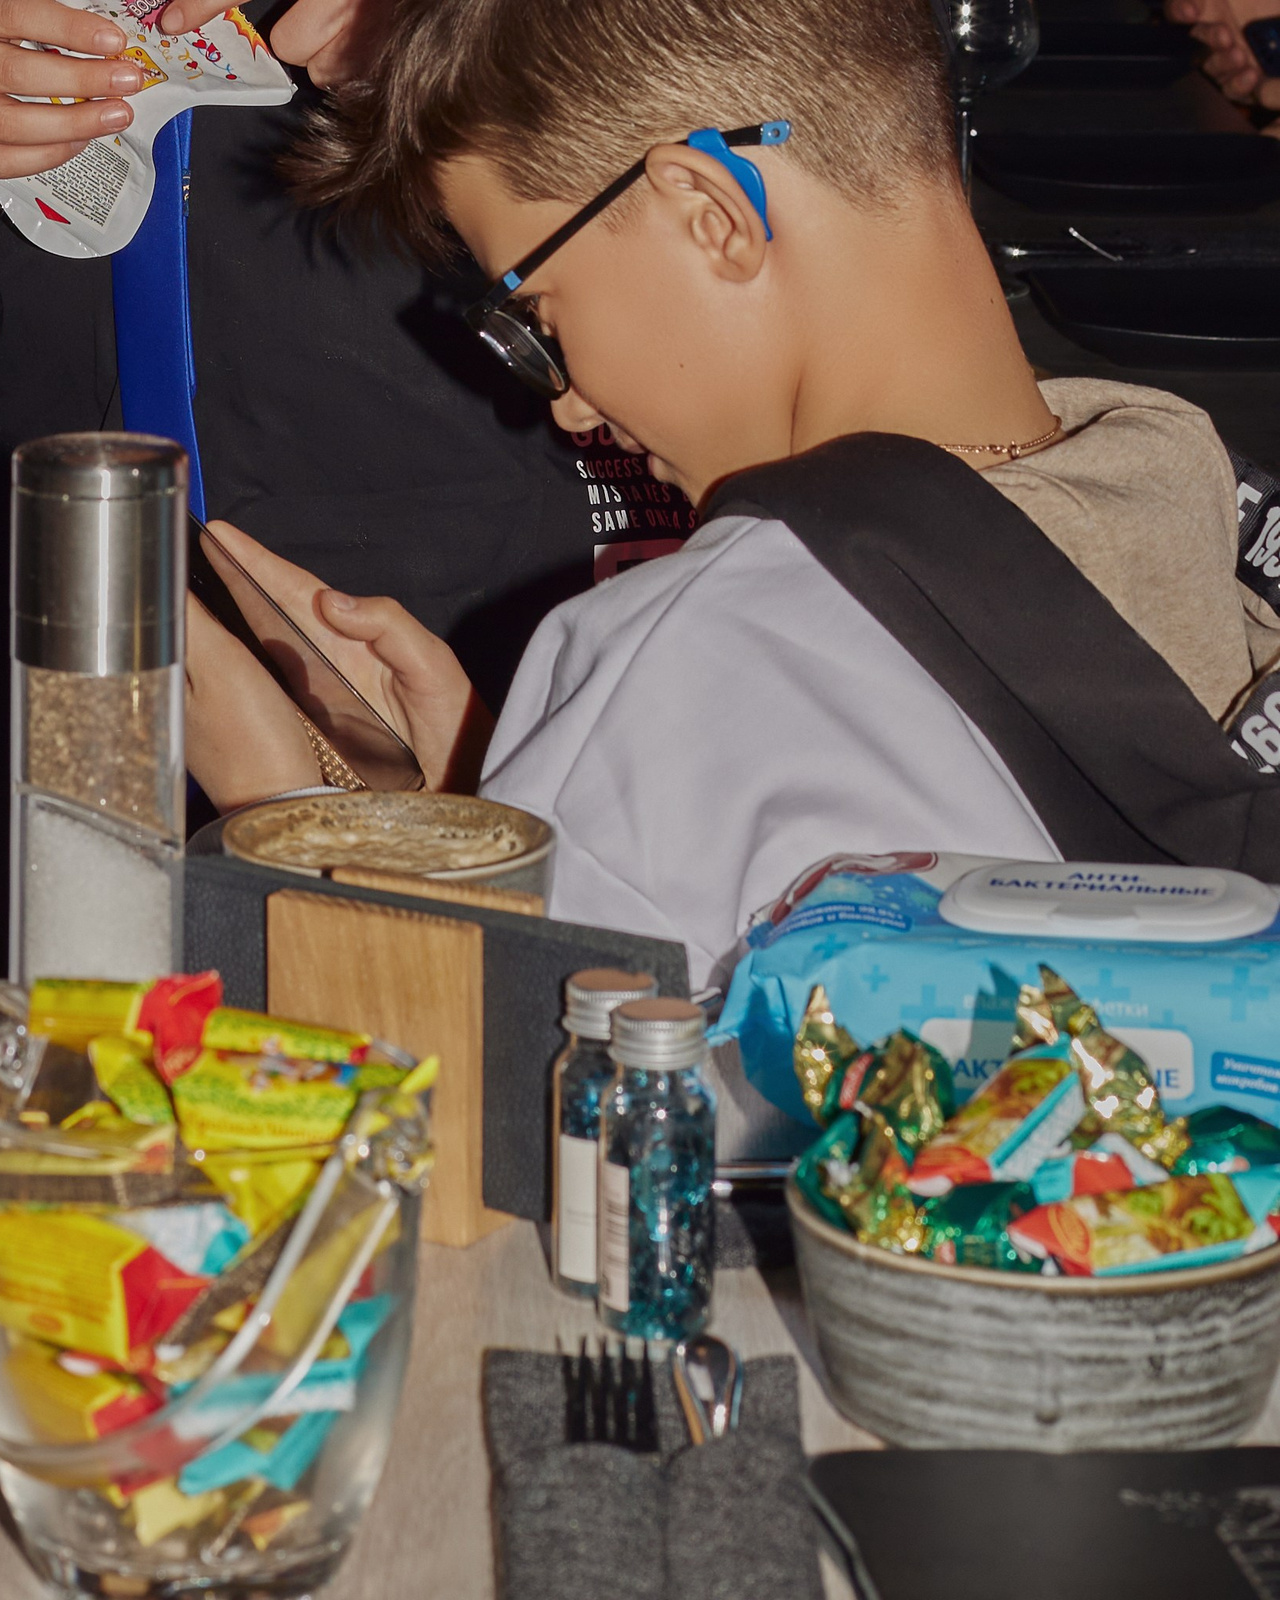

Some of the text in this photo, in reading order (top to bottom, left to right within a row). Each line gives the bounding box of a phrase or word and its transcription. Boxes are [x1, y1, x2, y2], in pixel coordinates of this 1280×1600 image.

[575, 457, 643, 479] SUCCESS
[591, 509, 641, 533] SAME
[988, 878, 1217, 898] БАКТЕРИАЛЬНЫЕ
